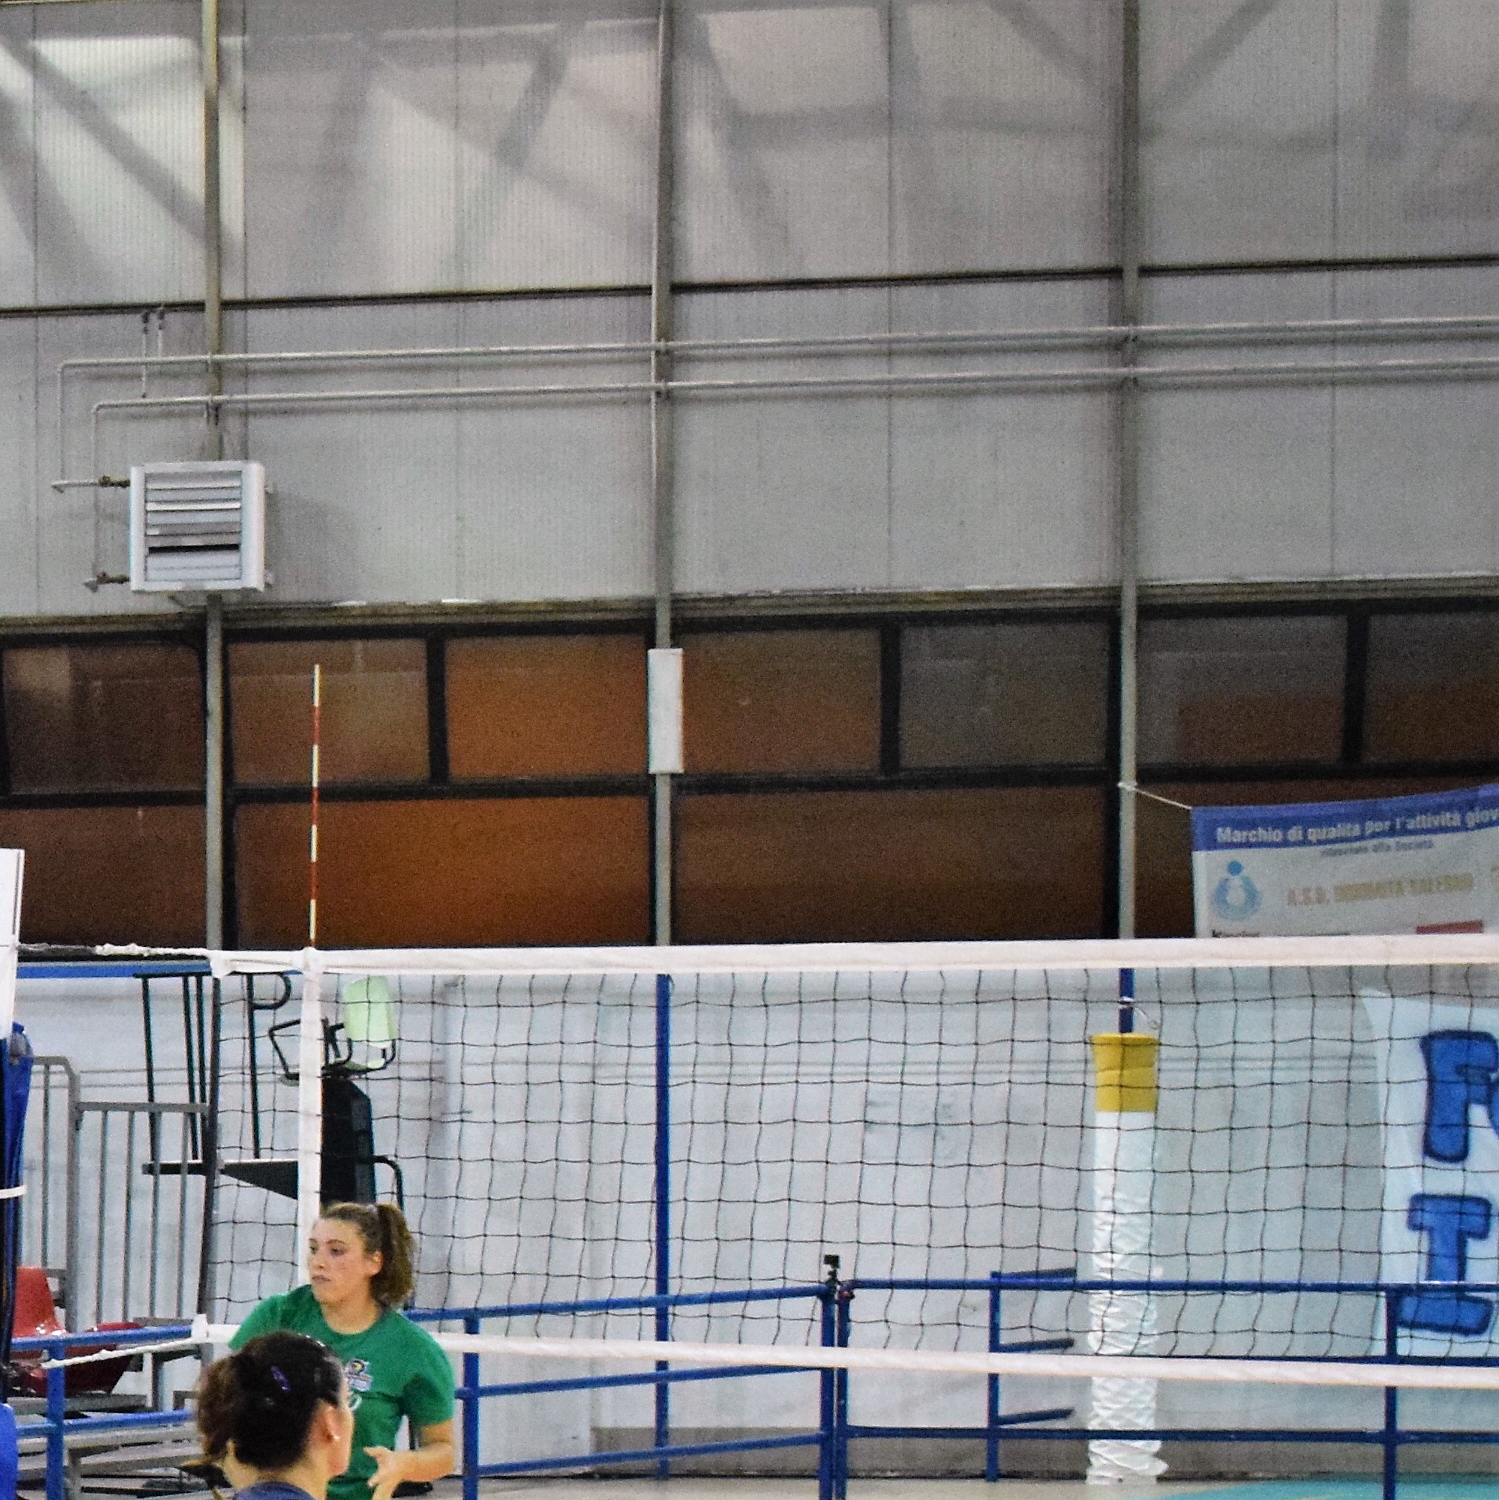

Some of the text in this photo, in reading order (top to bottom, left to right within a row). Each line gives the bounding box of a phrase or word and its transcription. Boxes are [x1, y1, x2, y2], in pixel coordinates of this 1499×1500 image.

[1216, 825, 1283, 842] Marchio
[1287, 824, 1303, 842] di
[1365, 820, 1391, 836] per
